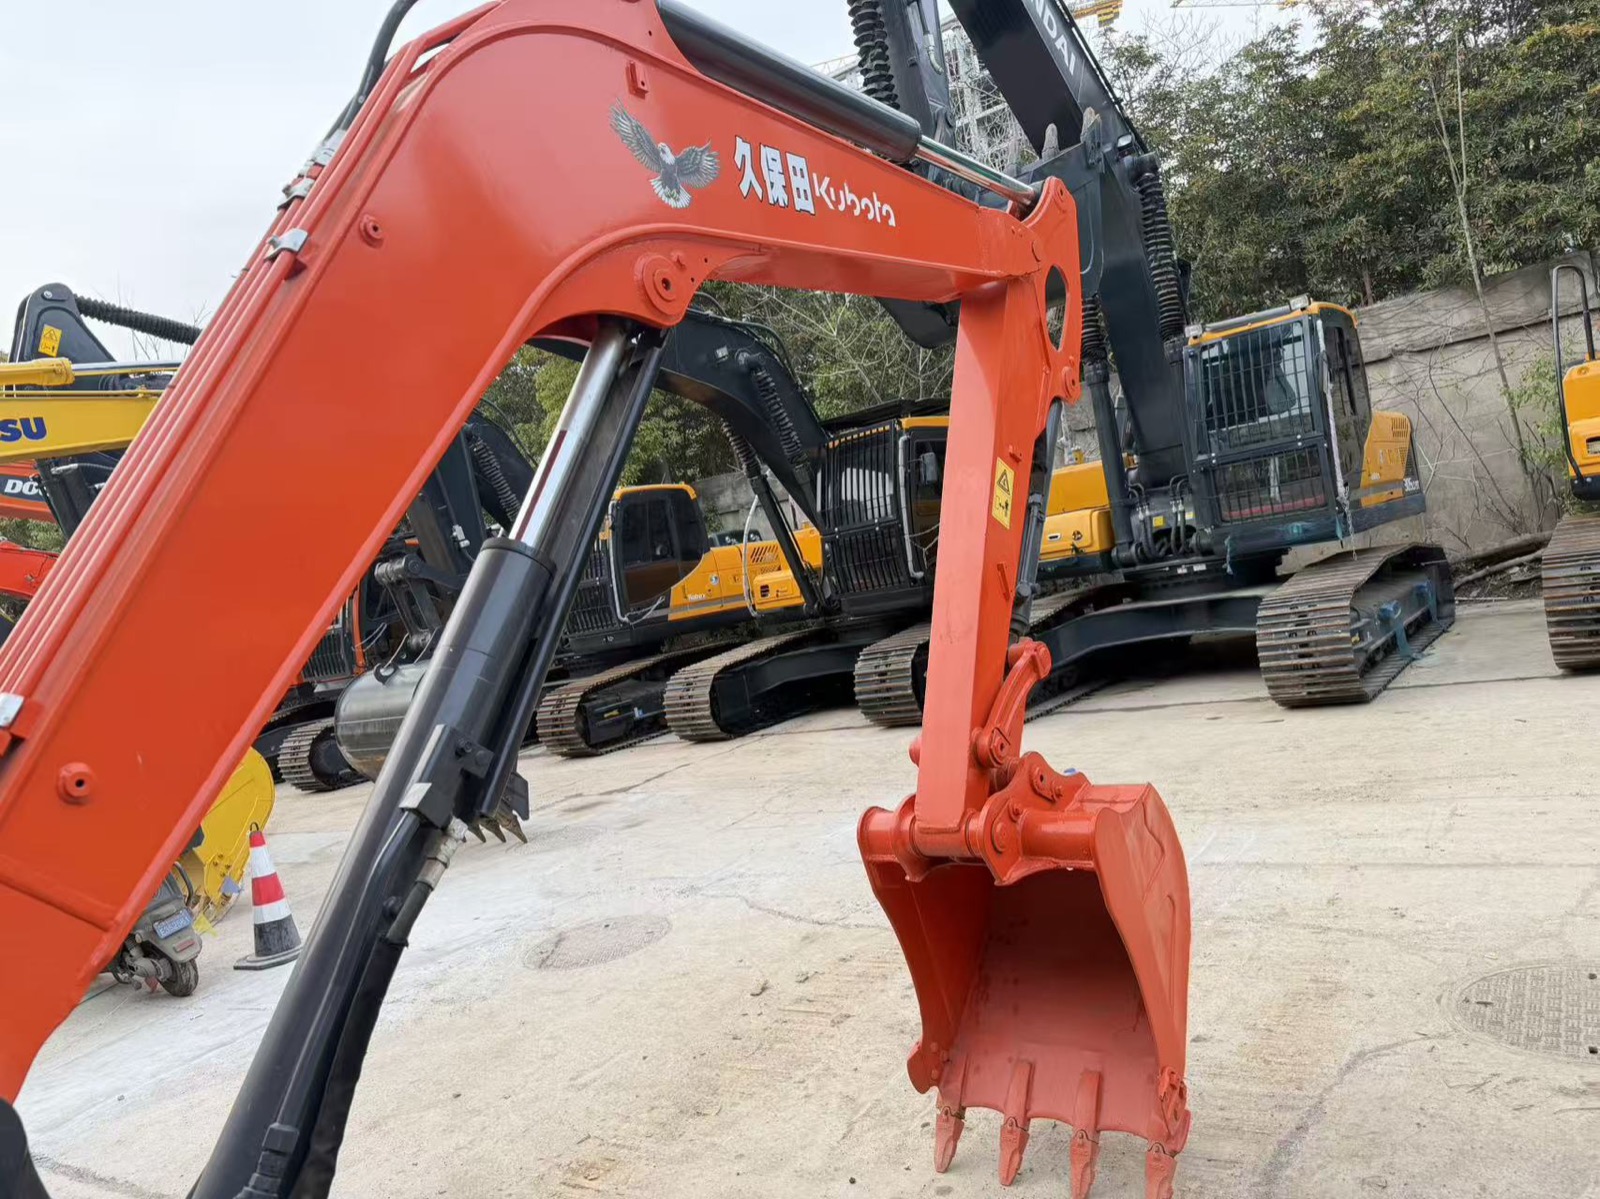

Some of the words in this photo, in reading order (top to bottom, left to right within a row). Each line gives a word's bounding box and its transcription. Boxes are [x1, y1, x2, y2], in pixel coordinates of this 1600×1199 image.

[733, 135, 815, 216] 久保田
[813, 172, 896, 227] Kubota
[0, 417, 48, 442] SU
